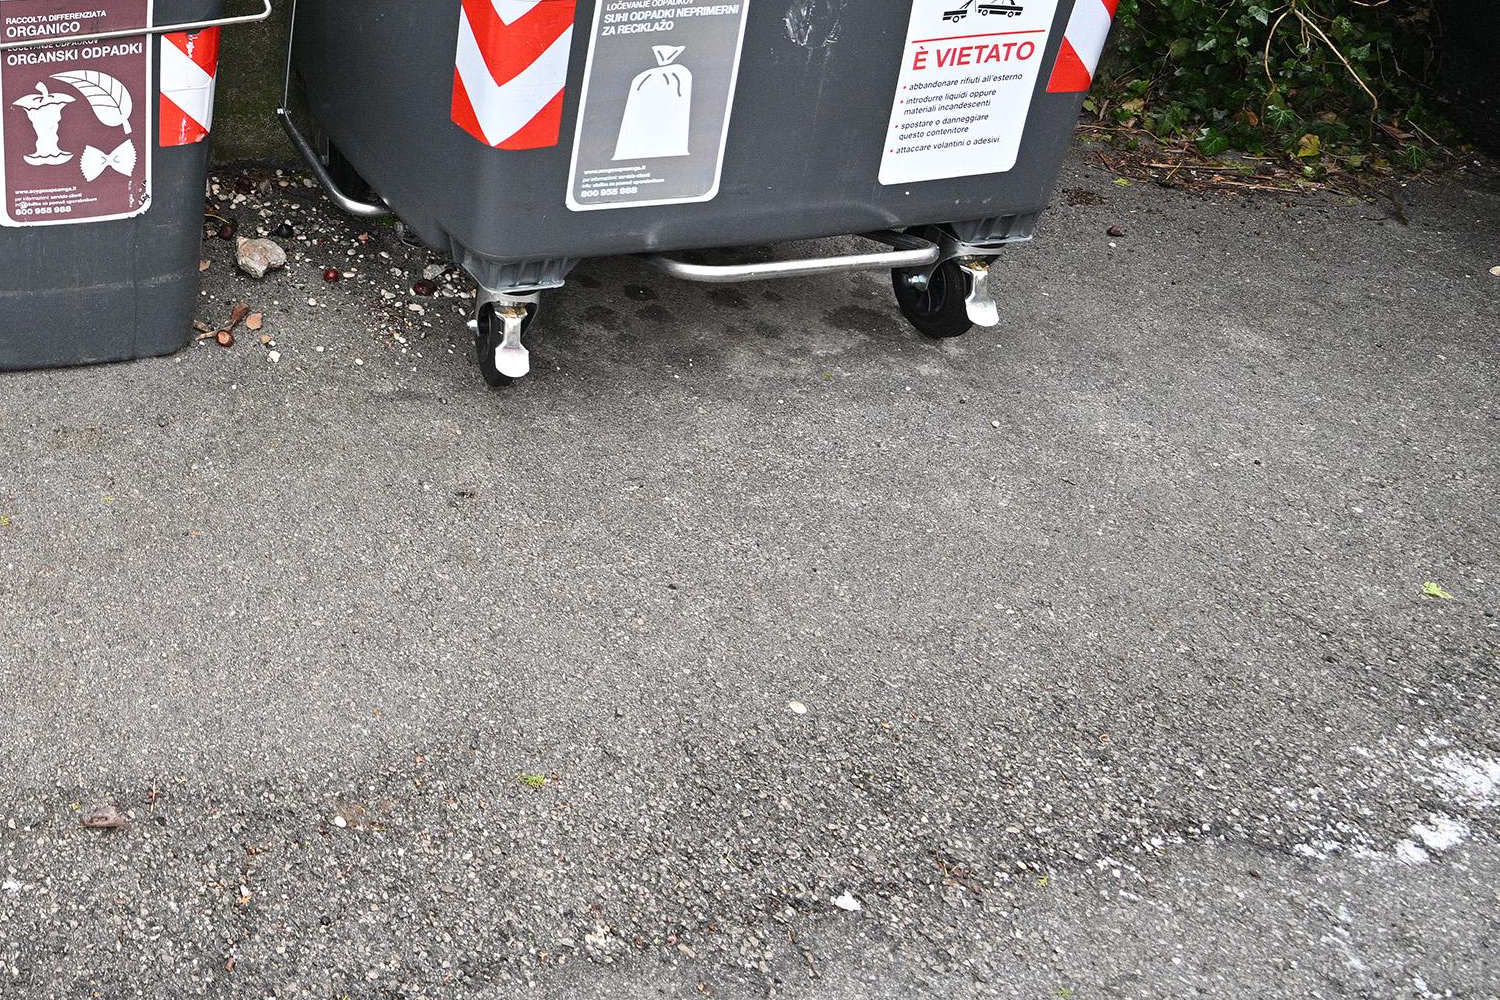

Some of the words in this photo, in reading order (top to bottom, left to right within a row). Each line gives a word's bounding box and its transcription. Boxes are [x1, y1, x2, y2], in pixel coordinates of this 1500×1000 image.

[604, 12, 628, 23] SUHI
[630, 9, 674, 21] ODPADKI
[676, 4, 740, 17] NEPRIMERNI
[607, 0, 650, 11] LOČEVANJE
[6, 16, 47, 24] RACCOLTA
[49, 10, 106, 22] DIFFERENZIATA
[6, 22, 80, 38] ORGANICO
[602, 26, 616, 36] ZA
[617, 19, 674, 34] RECIKLAŽO
[7, 51, 78, 66] ORGANSKI
[82, 42, 142, 59] ODPADKI
[913, 46, 928, 70] È
[937, 41, 1035, 68] VIETATO
[909, 78, 958, 91] abbandonare
[960, 76, 980, 85] rifiuti
[982, 73, 1023, 83] all'esterno
[906, 94, 943, 105] introdurre
[945, 91, 967, 101] liquidi
[969, 89, 996, 99] oppure
[904, 105, 936, 116] materiali
[938, 99, 991, 112] incandescenti
[901, 119, 933, 130] spostare
[942, 113, 989, 126] danneggiare
[899, 131, 924, 141] questo
[926, 126, 969, 138] contenitore
[896, 143, 931, 154] attaccare
[933, 138, 964, 149] volantini
[973, 135, 1000, 145] adesivi
[600, 188, 618, 196] 955
